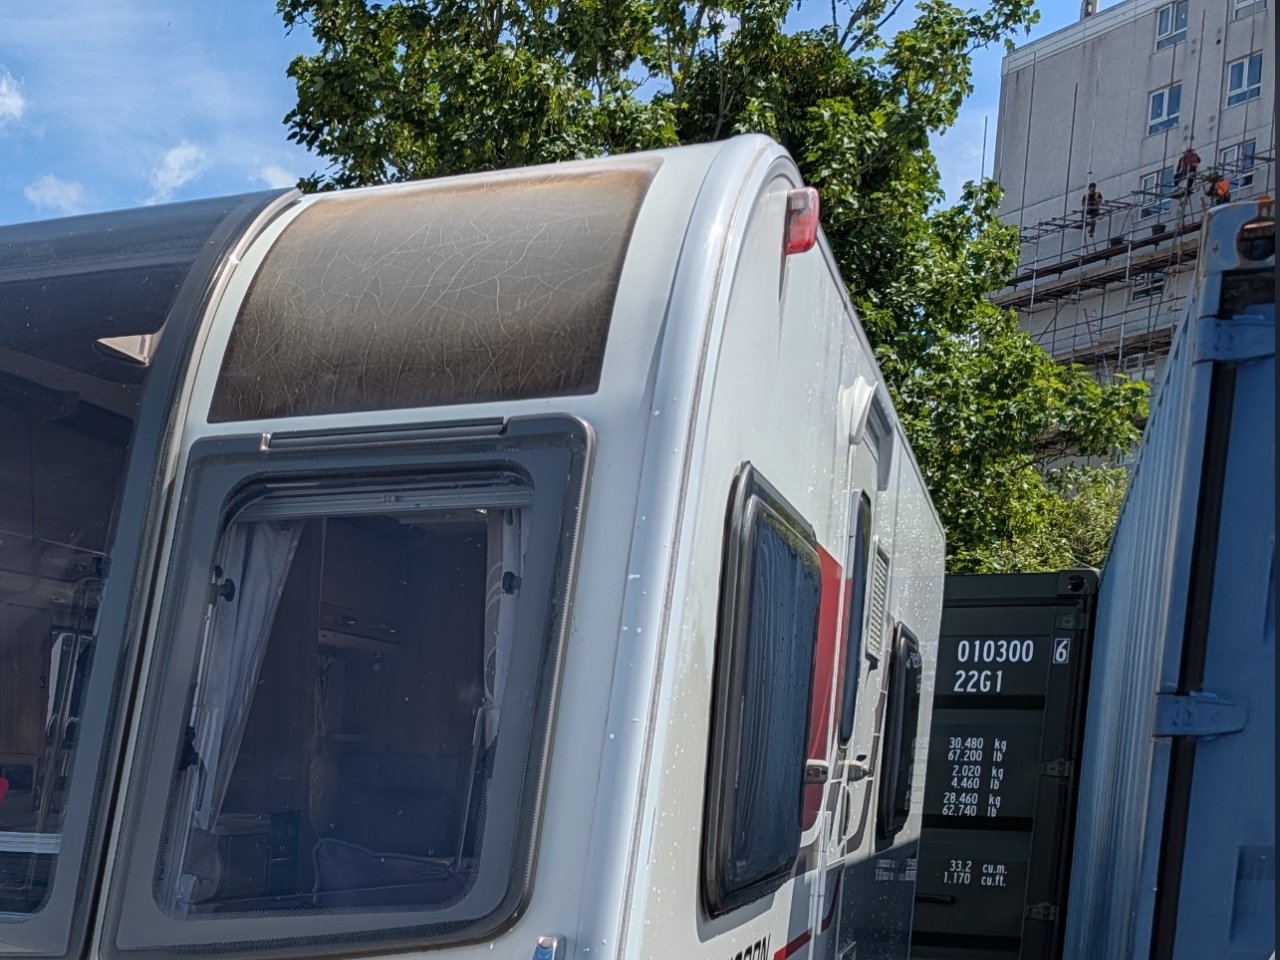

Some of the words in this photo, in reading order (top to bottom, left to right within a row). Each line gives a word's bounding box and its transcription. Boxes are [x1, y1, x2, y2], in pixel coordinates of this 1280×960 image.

[957, 639, 1035, 663] 010300
[1055, 640, 1068, 662] 6
[953, 669, 1003, 693] 22G1
[948, 736, 984, 750] 30.480
[994, 737, 1007, 753] kg
[947, 749, 983, 762] 67.200
[992, 749, 1003, 762] lb
[952, 764, 981, 777] 2.020
[991, 765, 1004, 781] kg
[950, 776, 980, 789] 4.460
[989, 777, 1000, 790] lb
[943, 791, 979, 805] 28.460
[988, 793, 1001, 809] kg
[942, 804, 977, 817] 62.740
[987, 805, 997, 818] lb
[950, 859, 972, 873] 33.2
[982, 863, 1008, 875] cu.m.
[943, 871, 971, 885] 1.170
[981, 873, 1006, 887] cu.ft.
